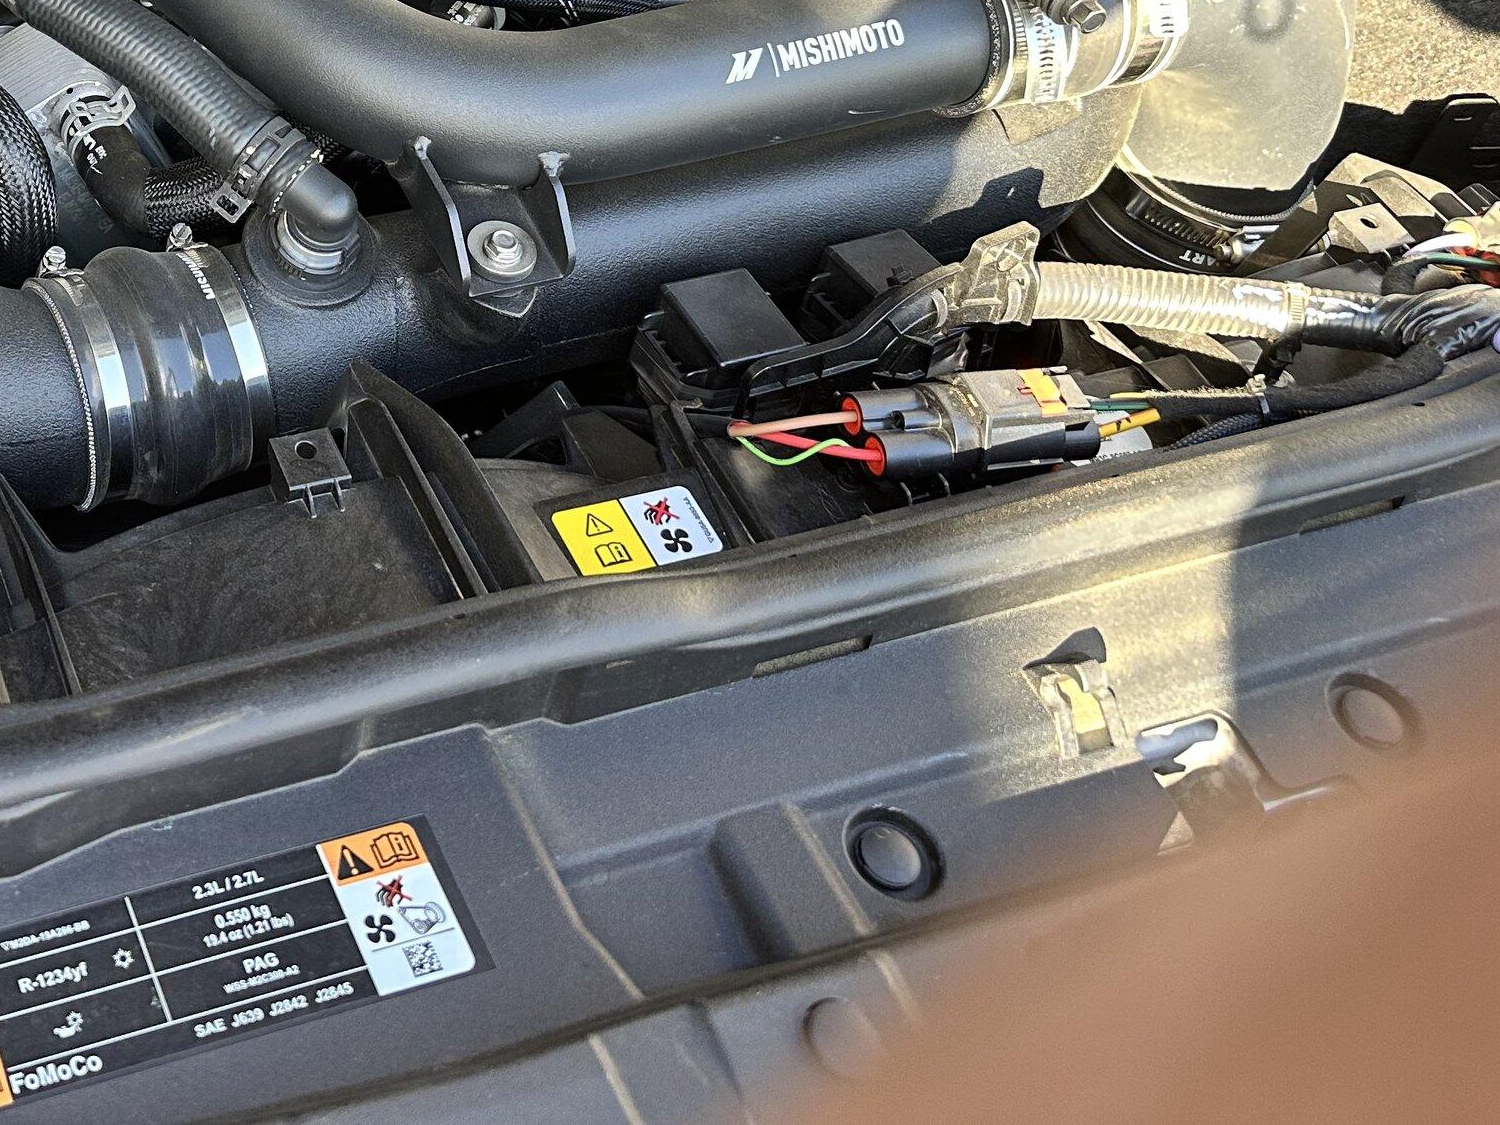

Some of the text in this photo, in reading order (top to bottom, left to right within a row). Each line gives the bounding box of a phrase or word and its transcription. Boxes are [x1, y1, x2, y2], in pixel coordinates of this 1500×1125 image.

[776, 18, 905, 72] MISHIMOTO
[1178, 249, 1220, 268] ART
[191, 879, 225, 900] 2.3L
[231, 869, 265, 888] 2.7L
[214, 904, 272, 929] 0.550 kg
[227, 929, 244, 942] oz
[17, 961, 89, 994] R-1234yf
[242, 952, 280, 974] PAG
[194, 981, 355, 1038] SAE J639 J2842 J2845
[8, 1054, 103, 1095] FoMoCo
